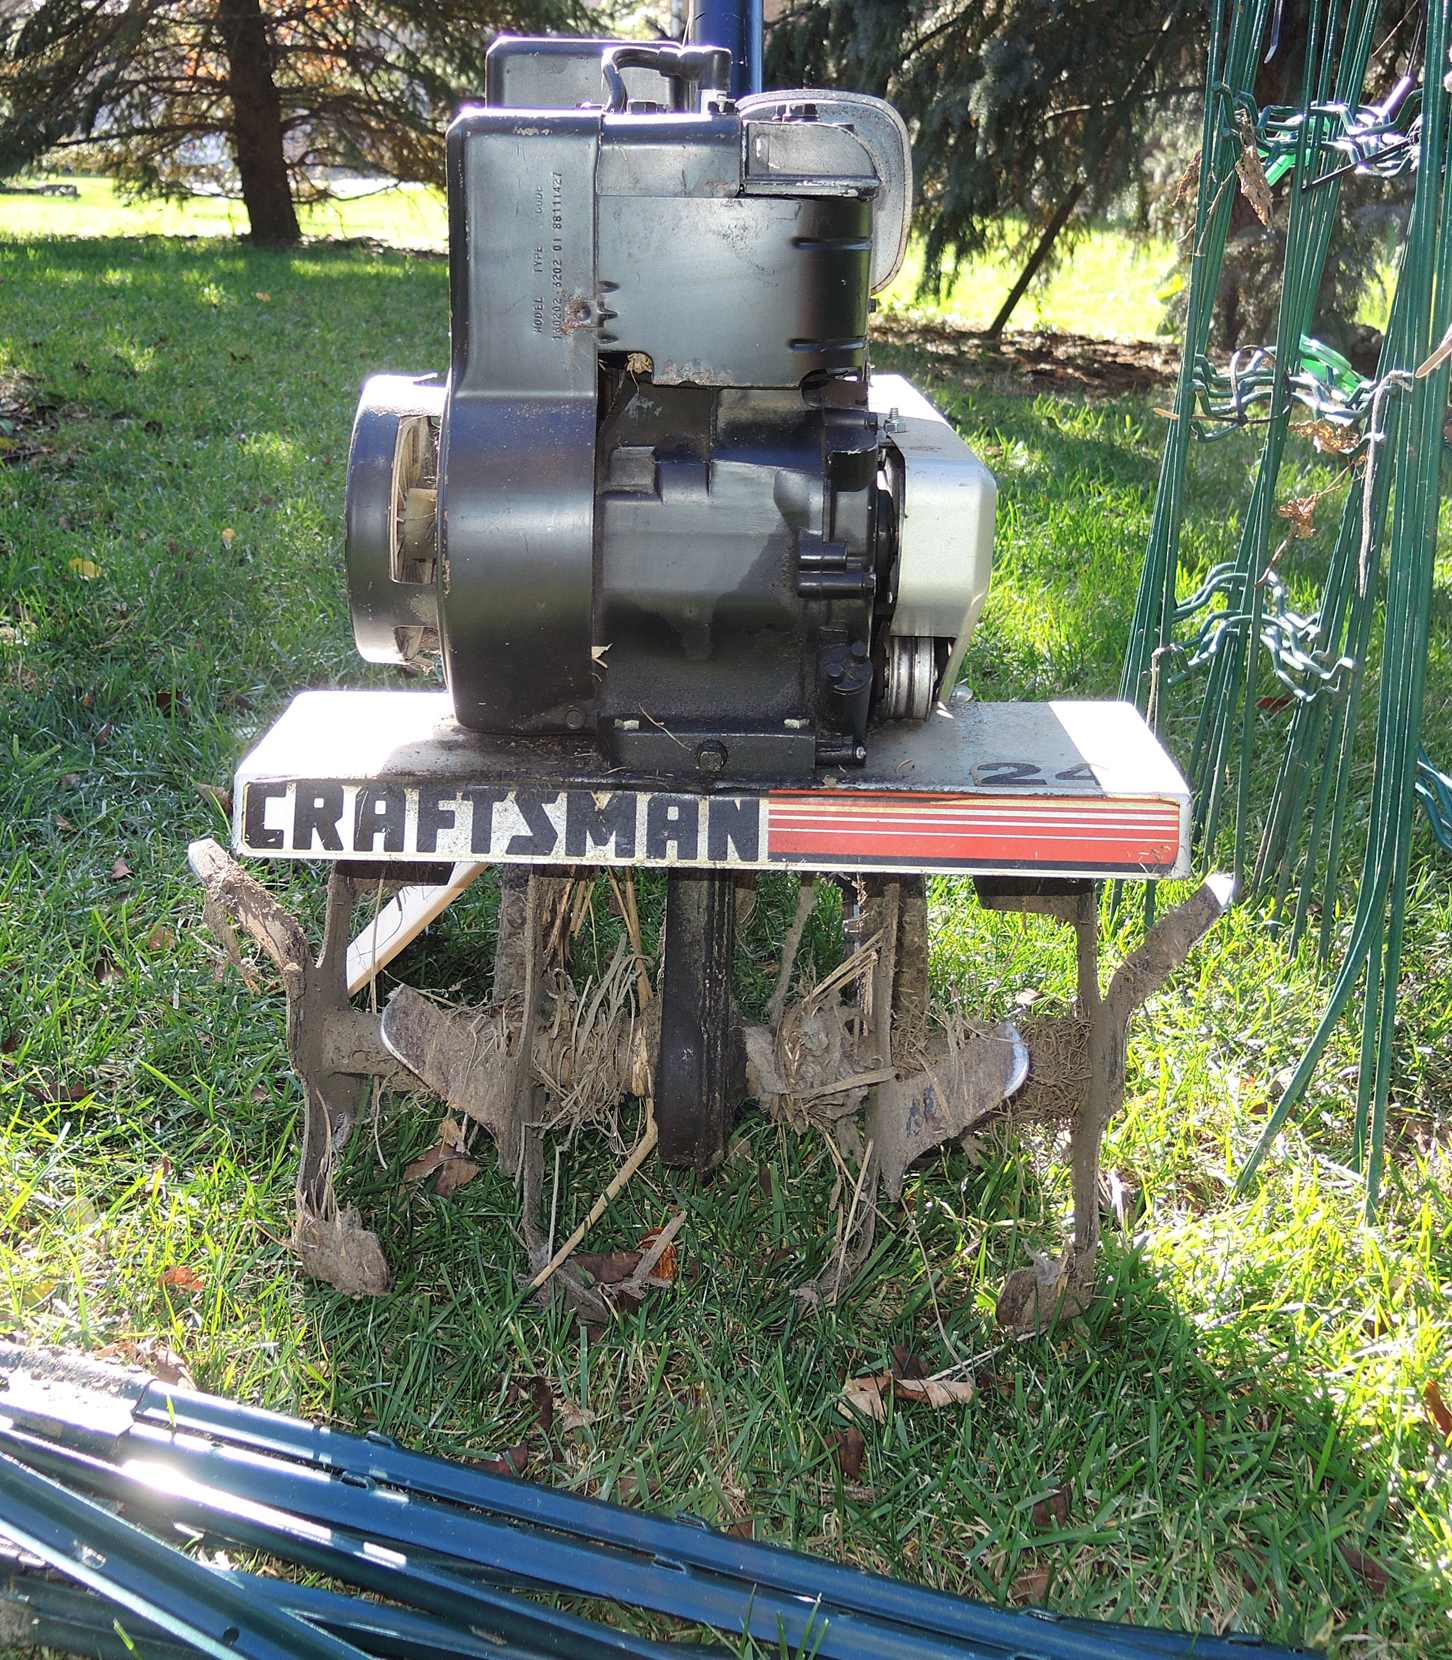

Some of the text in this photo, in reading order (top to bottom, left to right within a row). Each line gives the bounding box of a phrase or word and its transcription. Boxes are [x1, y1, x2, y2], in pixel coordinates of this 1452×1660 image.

[551, 171, 563, 231] 88111427
[533, 185, 544, 335] MODEL TYPE CODE
[551, 238, 562, 252] 01
[245, 779, 761, 862] CRAFTSMAN
